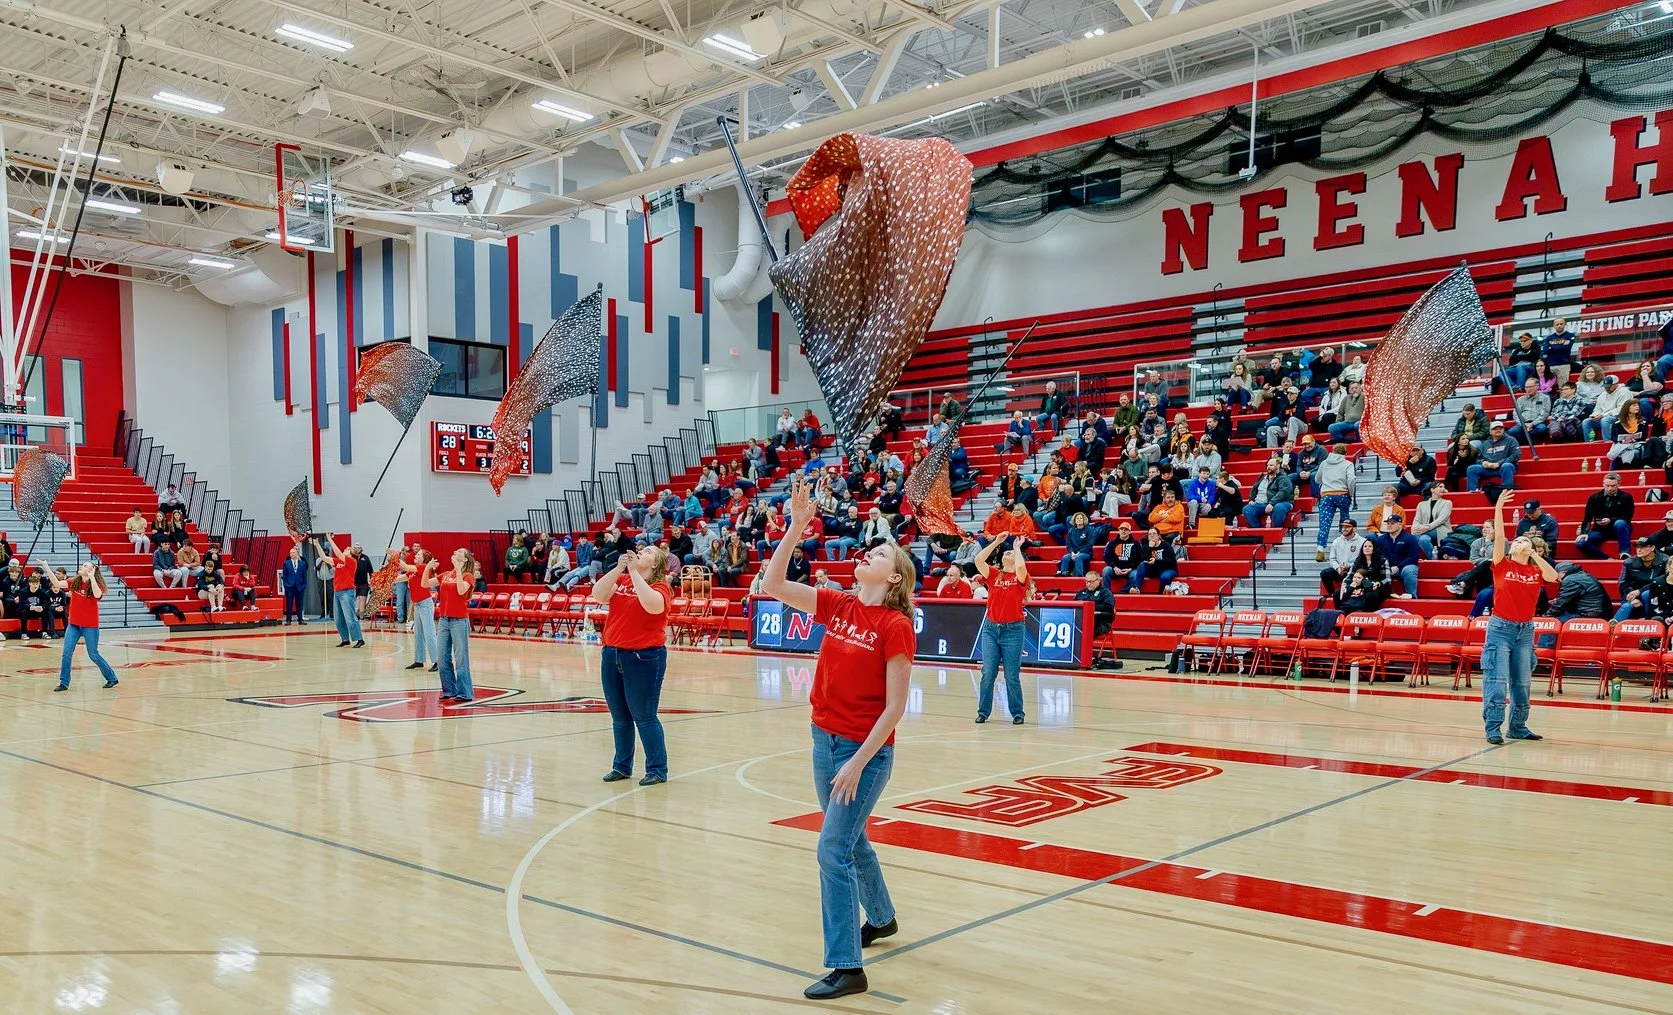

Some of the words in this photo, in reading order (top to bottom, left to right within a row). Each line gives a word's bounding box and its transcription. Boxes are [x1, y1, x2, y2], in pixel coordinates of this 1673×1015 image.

[1160, 108, 1673, 275] NEENAH
[1566, 314, 1634, 333] VISITING
[1638, 309, 1673, 328] PAR
[437, 423, 466, 433] ROCKETS
[442, 435, 456, 449] 28
[442, 455, 448, 466] 5
[481, 457, 487, 468] 3
[1197, 612, 1222, 621] NEENAH
[1237, 613, 1262, 621] NEENAH
[1275, 614, 1300, 623] NEENAH
[1349, 615, 1377, 625] NEENAH
[1389, 617, 1419, 626] NEENAH
[760, 612, 781, 635] 28
[1433, 618, 1463, 627] NEENAH
[1533, 621, 1555, 630] ENAH
[1569, 622, 1604, 632] NEENAH
[1621, 623, 1657, 634] NEENAH
[1042, 622, 1071, 648] 29
[938, 638, 947, 655] B
